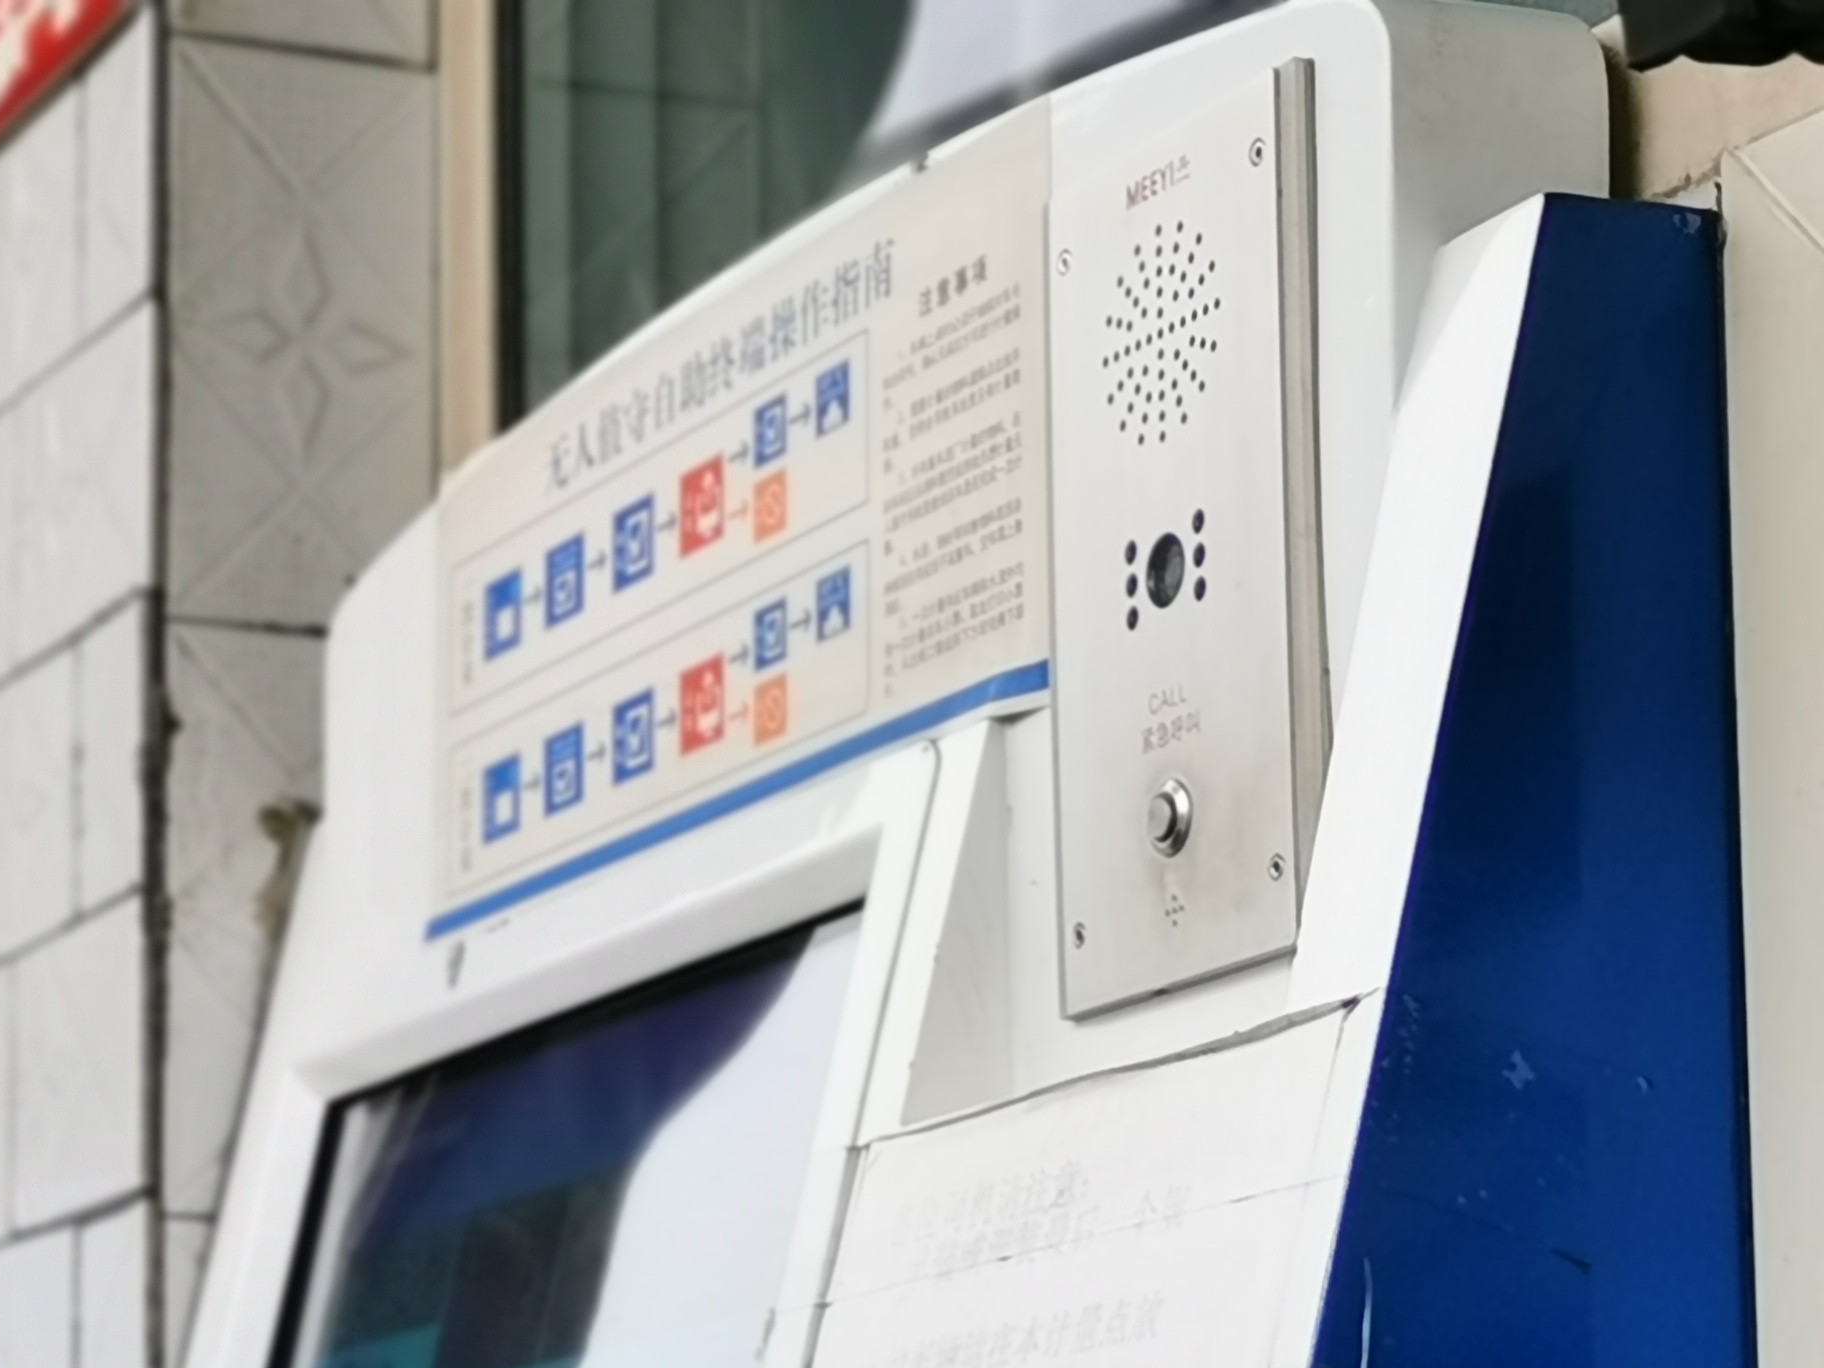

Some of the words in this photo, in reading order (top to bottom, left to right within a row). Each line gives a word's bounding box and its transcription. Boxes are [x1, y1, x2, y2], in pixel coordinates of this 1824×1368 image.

[547, 238, 895, 490] 无人值守自助终端操作指南
[1148, 682, 1187, 715] CALL
